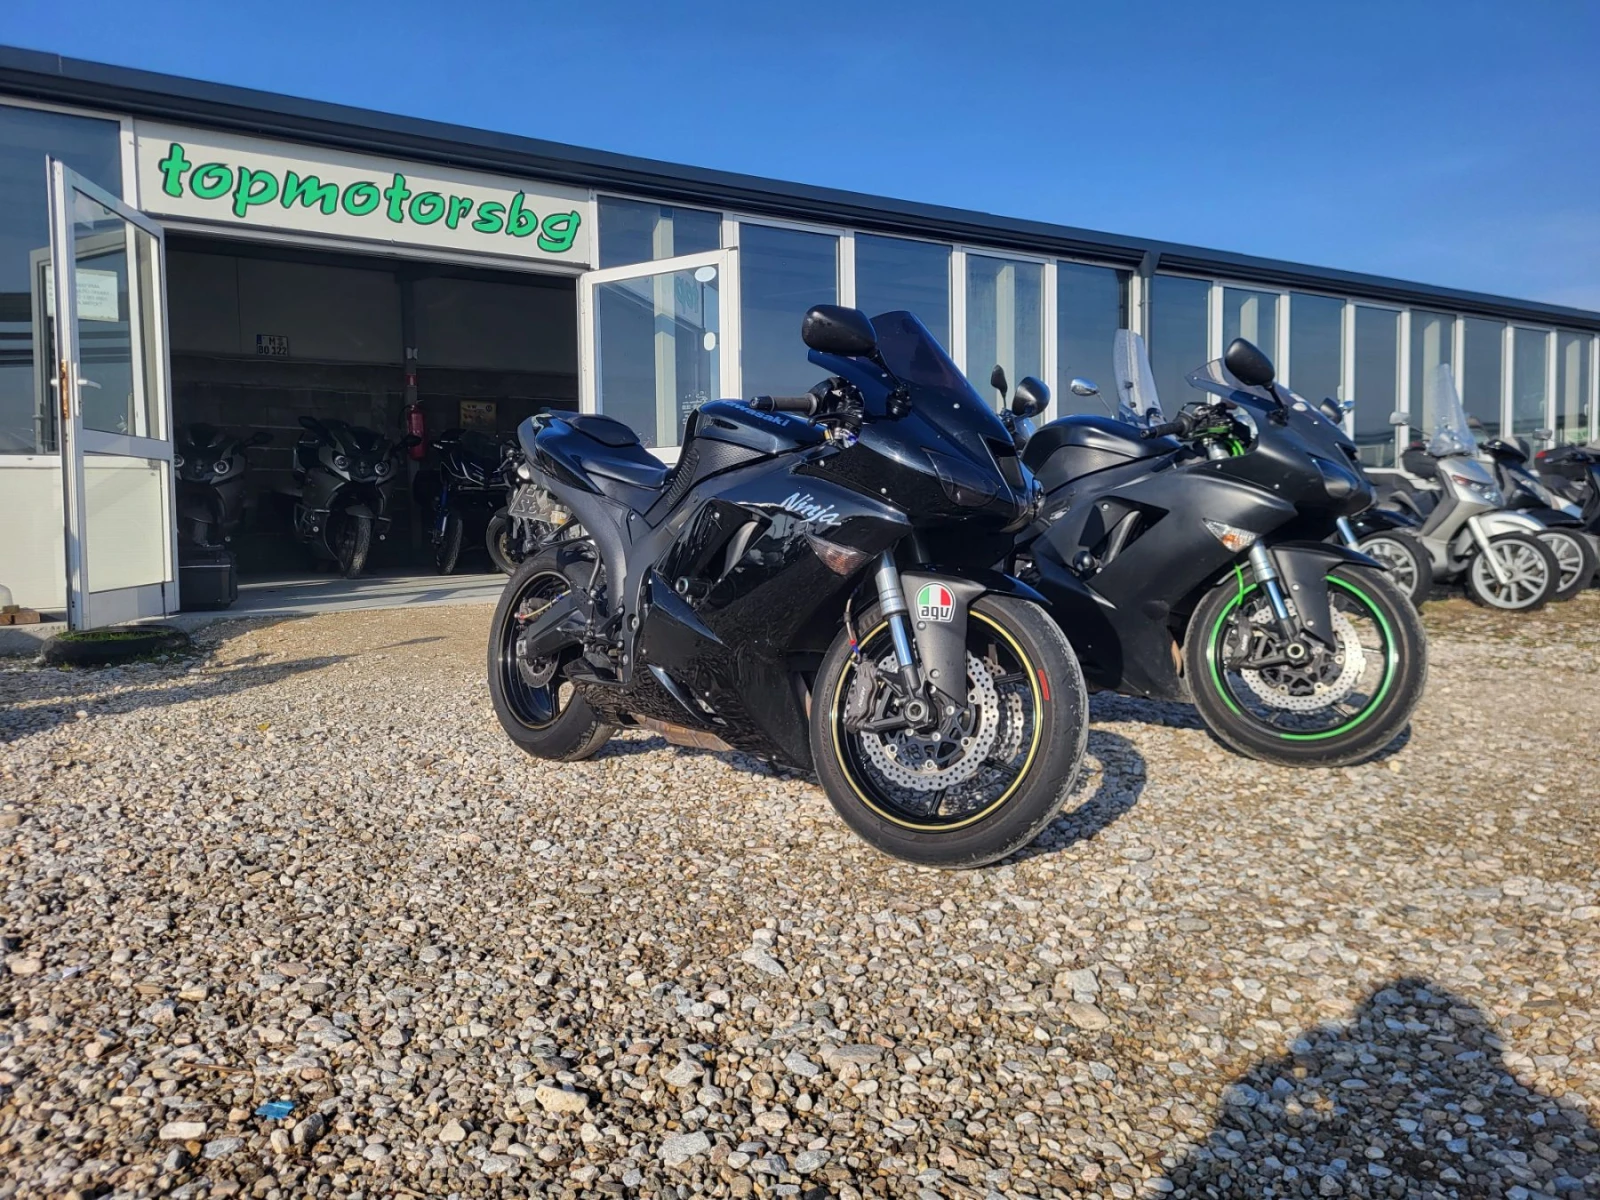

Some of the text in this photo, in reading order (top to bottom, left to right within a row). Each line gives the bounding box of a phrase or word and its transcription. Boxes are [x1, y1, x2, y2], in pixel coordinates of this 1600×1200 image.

[158, 142, 582, 254] topmotorsbg
[780, 492, 842, 526] Ninja
[921, 605, 950, 620] agv
